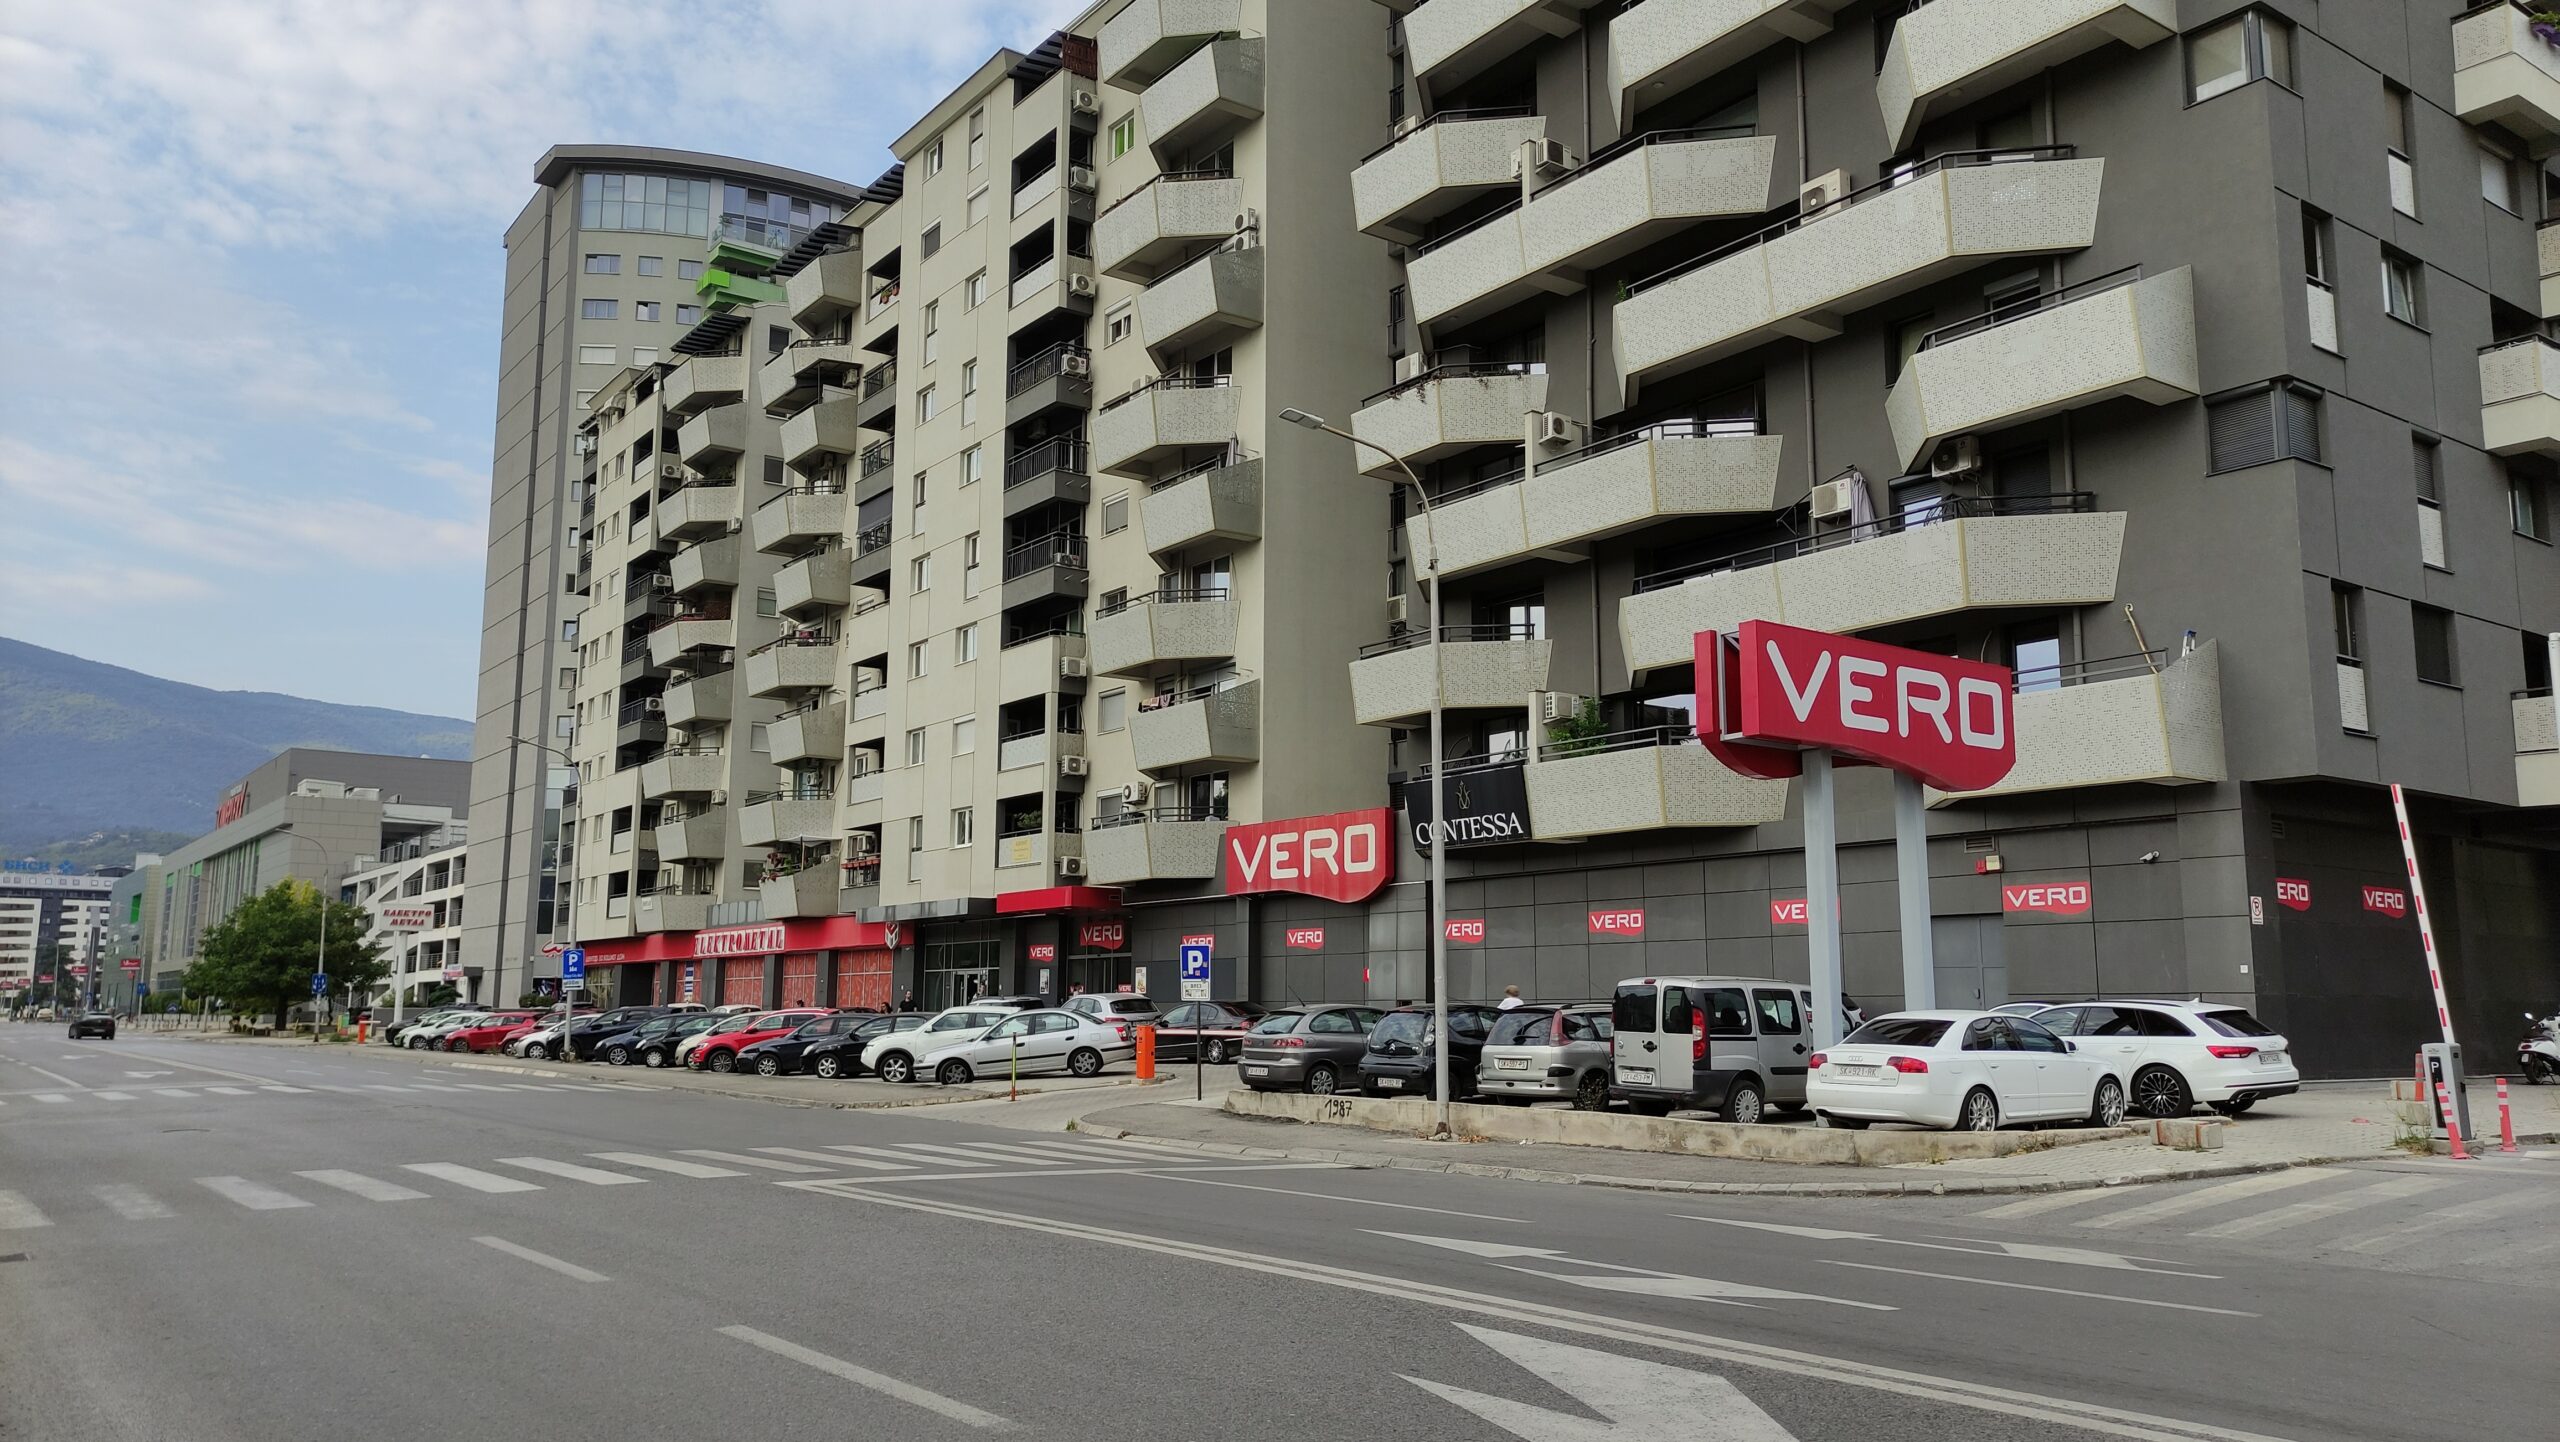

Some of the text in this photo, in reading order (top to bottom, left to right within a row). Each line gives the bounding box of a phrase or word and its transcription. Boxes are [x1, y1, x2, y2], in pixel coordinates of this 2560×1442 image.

[1766, 639, 2005, 750] VERO
[1415, 812, 1524, 845] CNTESSA
[1232, 823, 1376, 883] VERO
[2006, 886, 2087, 908] VERO
[2364, 889, 2404, 910] VERO
[383, 909, 432, 917] ЕЛЕКТРО
[1774, 903, 1808, 920] VE
[1591, 913, 1642, 929] VERO
[1082, 924, 1122, 942] VERO
[1288, 930, 1323, 944] VERO
[569, 953, 578, 966] P
[1030, 946, 1054, 957] VERO
[1187, 950, 1203, 975] P
[2431, 1061, 2440, 1073] P
[1324, 1099, 1352, 1119] 1987
